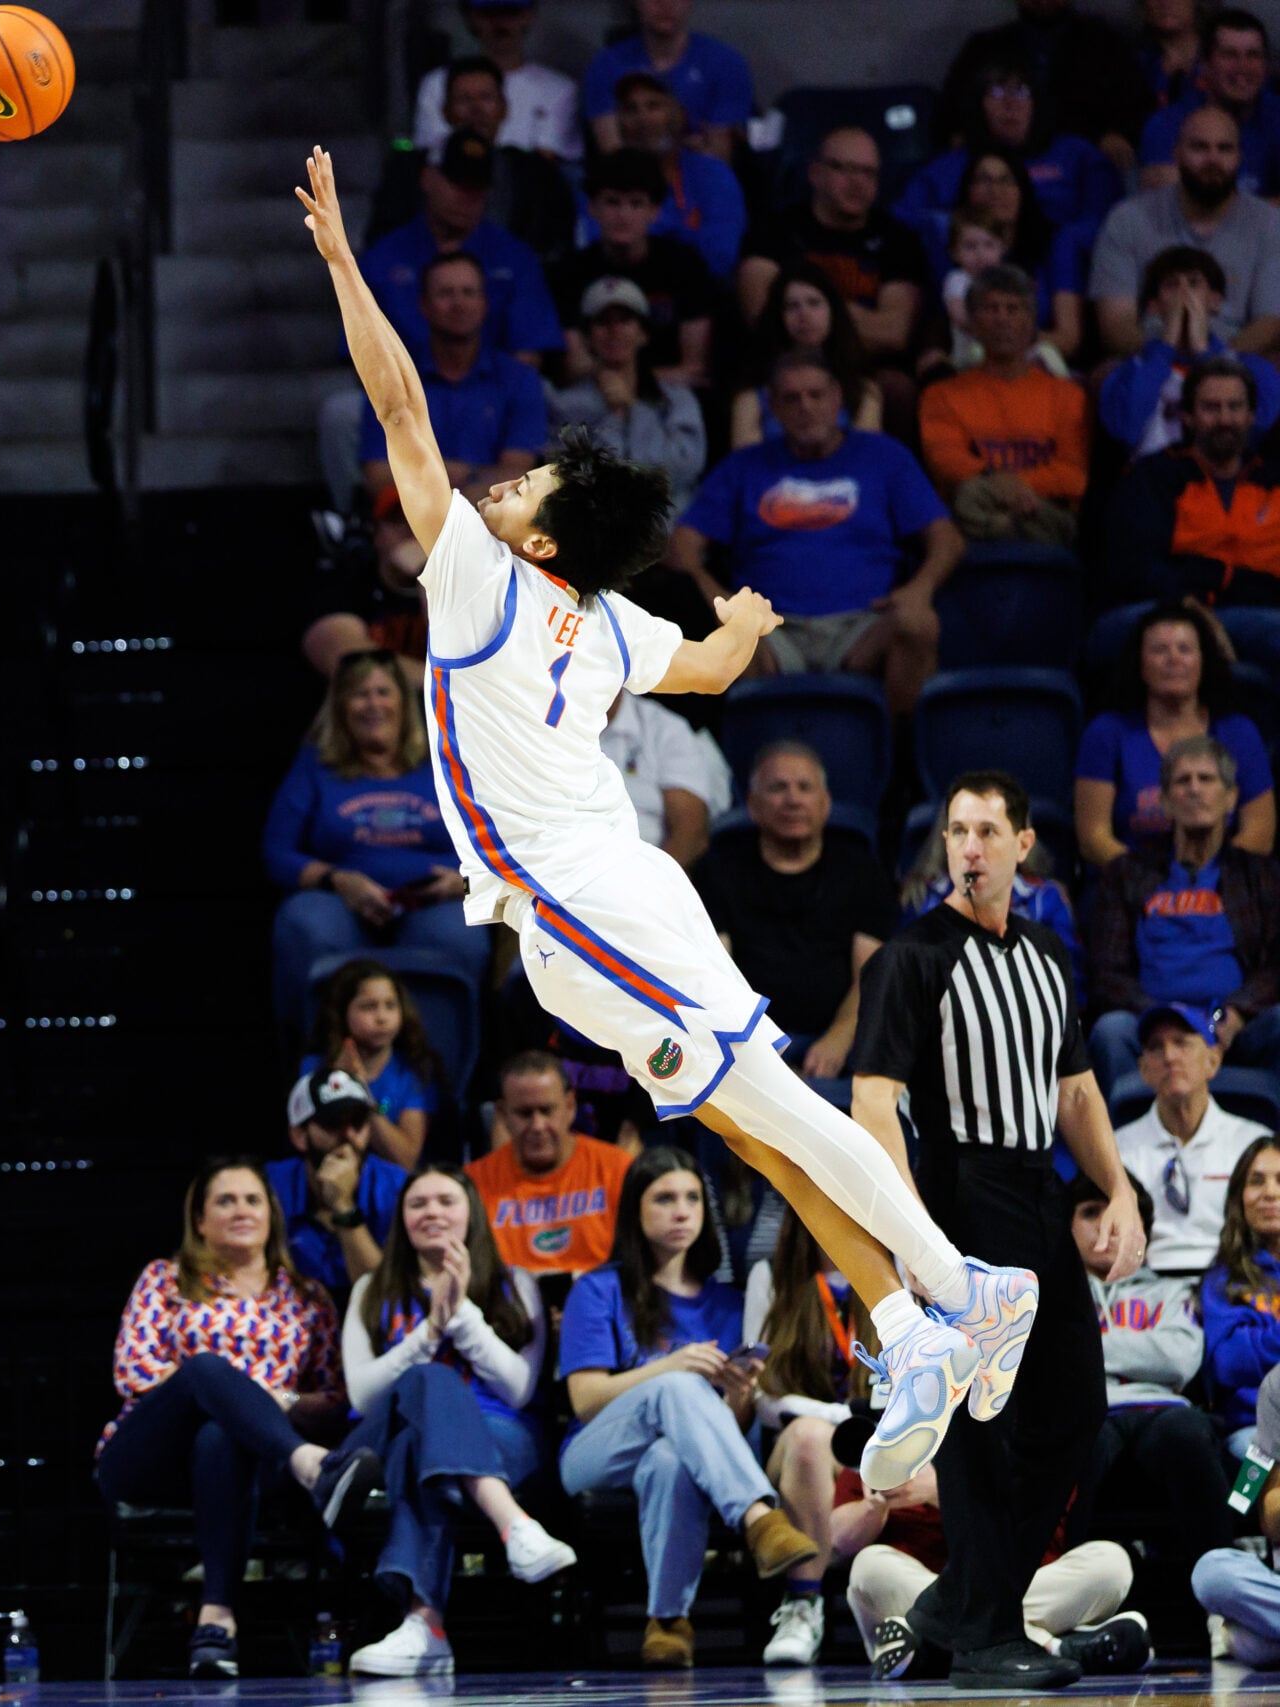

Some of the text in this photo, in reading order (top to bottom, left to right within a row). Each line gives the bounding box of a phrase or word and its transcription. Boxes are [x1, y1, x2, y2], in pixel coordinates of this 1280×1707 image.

[547, 605, 584, 648] LEE
[545, 650, 573, 729] 1
[492, 1186, 606, 1228] FLORIDA
